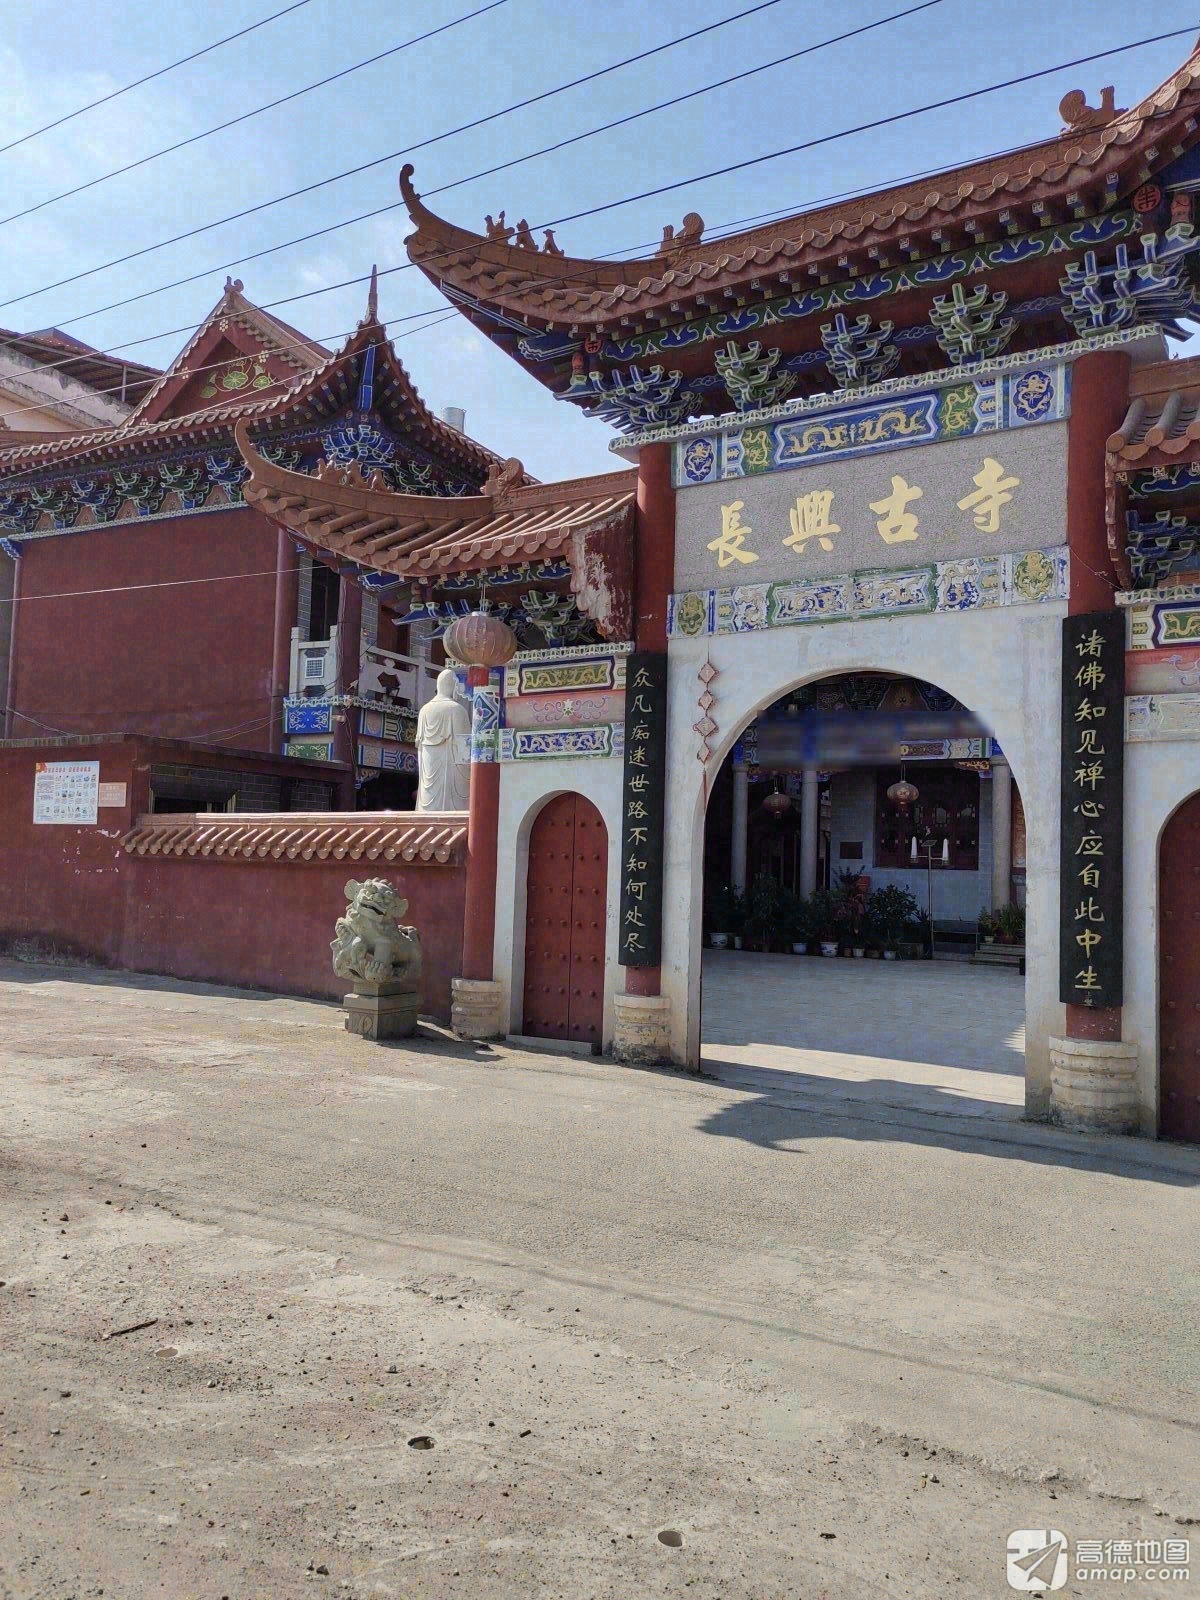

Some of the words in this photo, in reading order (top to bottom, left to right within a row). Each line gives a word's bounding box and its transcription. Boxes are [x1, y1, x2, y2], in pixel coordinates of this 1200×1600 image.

[707, 457, 1020, 567] 長興古寺
[623, 667, 654, 952] 众凡痴迷世路不知何处尽
[1073, 632, 1107, 990] 诸佛知见禅心应自此中生
